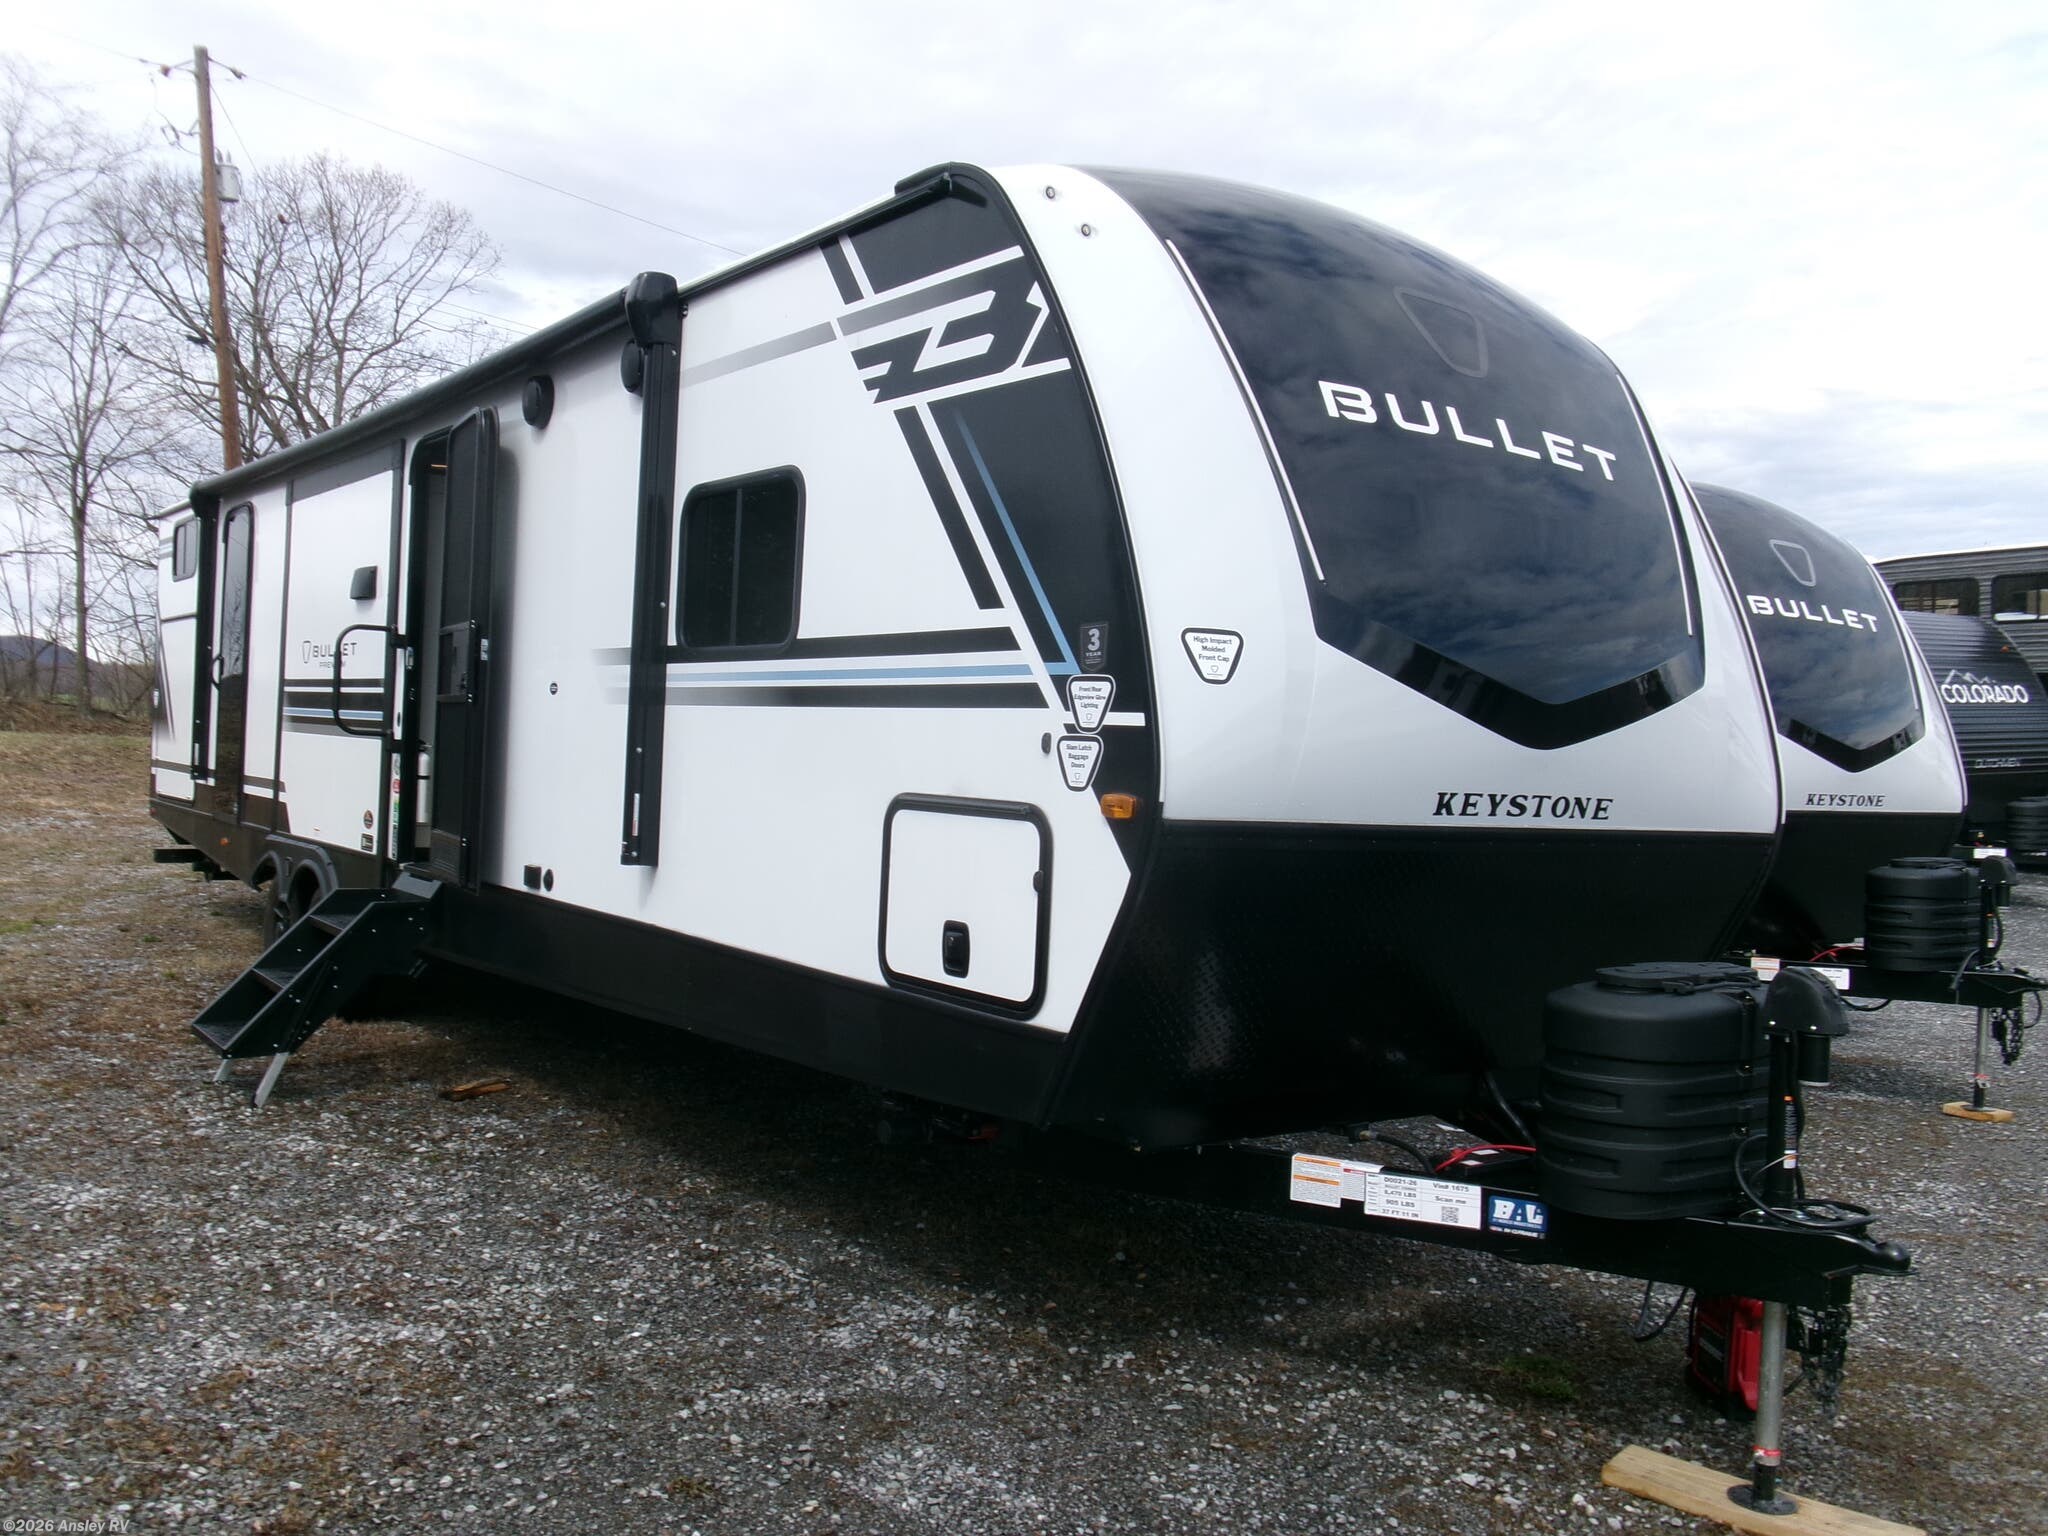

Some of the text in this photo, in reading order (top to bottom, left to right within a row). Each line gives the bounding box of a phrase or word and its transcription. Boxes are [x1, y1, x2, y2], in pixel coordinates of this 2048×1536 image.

[1318, 380, 1617, 481] BULLET
[1746, 594, 1878, 633] BULLET
[1087, 628, 1101, 651] 3
[1193, 635, 1233, 645] High Impact
[312, 642, 358, 658] BULET
[1198, 653, 1230, 663] Front Cap
[1201, 645, 1226, 653] Molded
[1941, 684, 2030, 704] COLORADO
[1432, 792, 1615, 820] KEYSTONE
[1805, 793, 1886, 807] KEYSTONE
